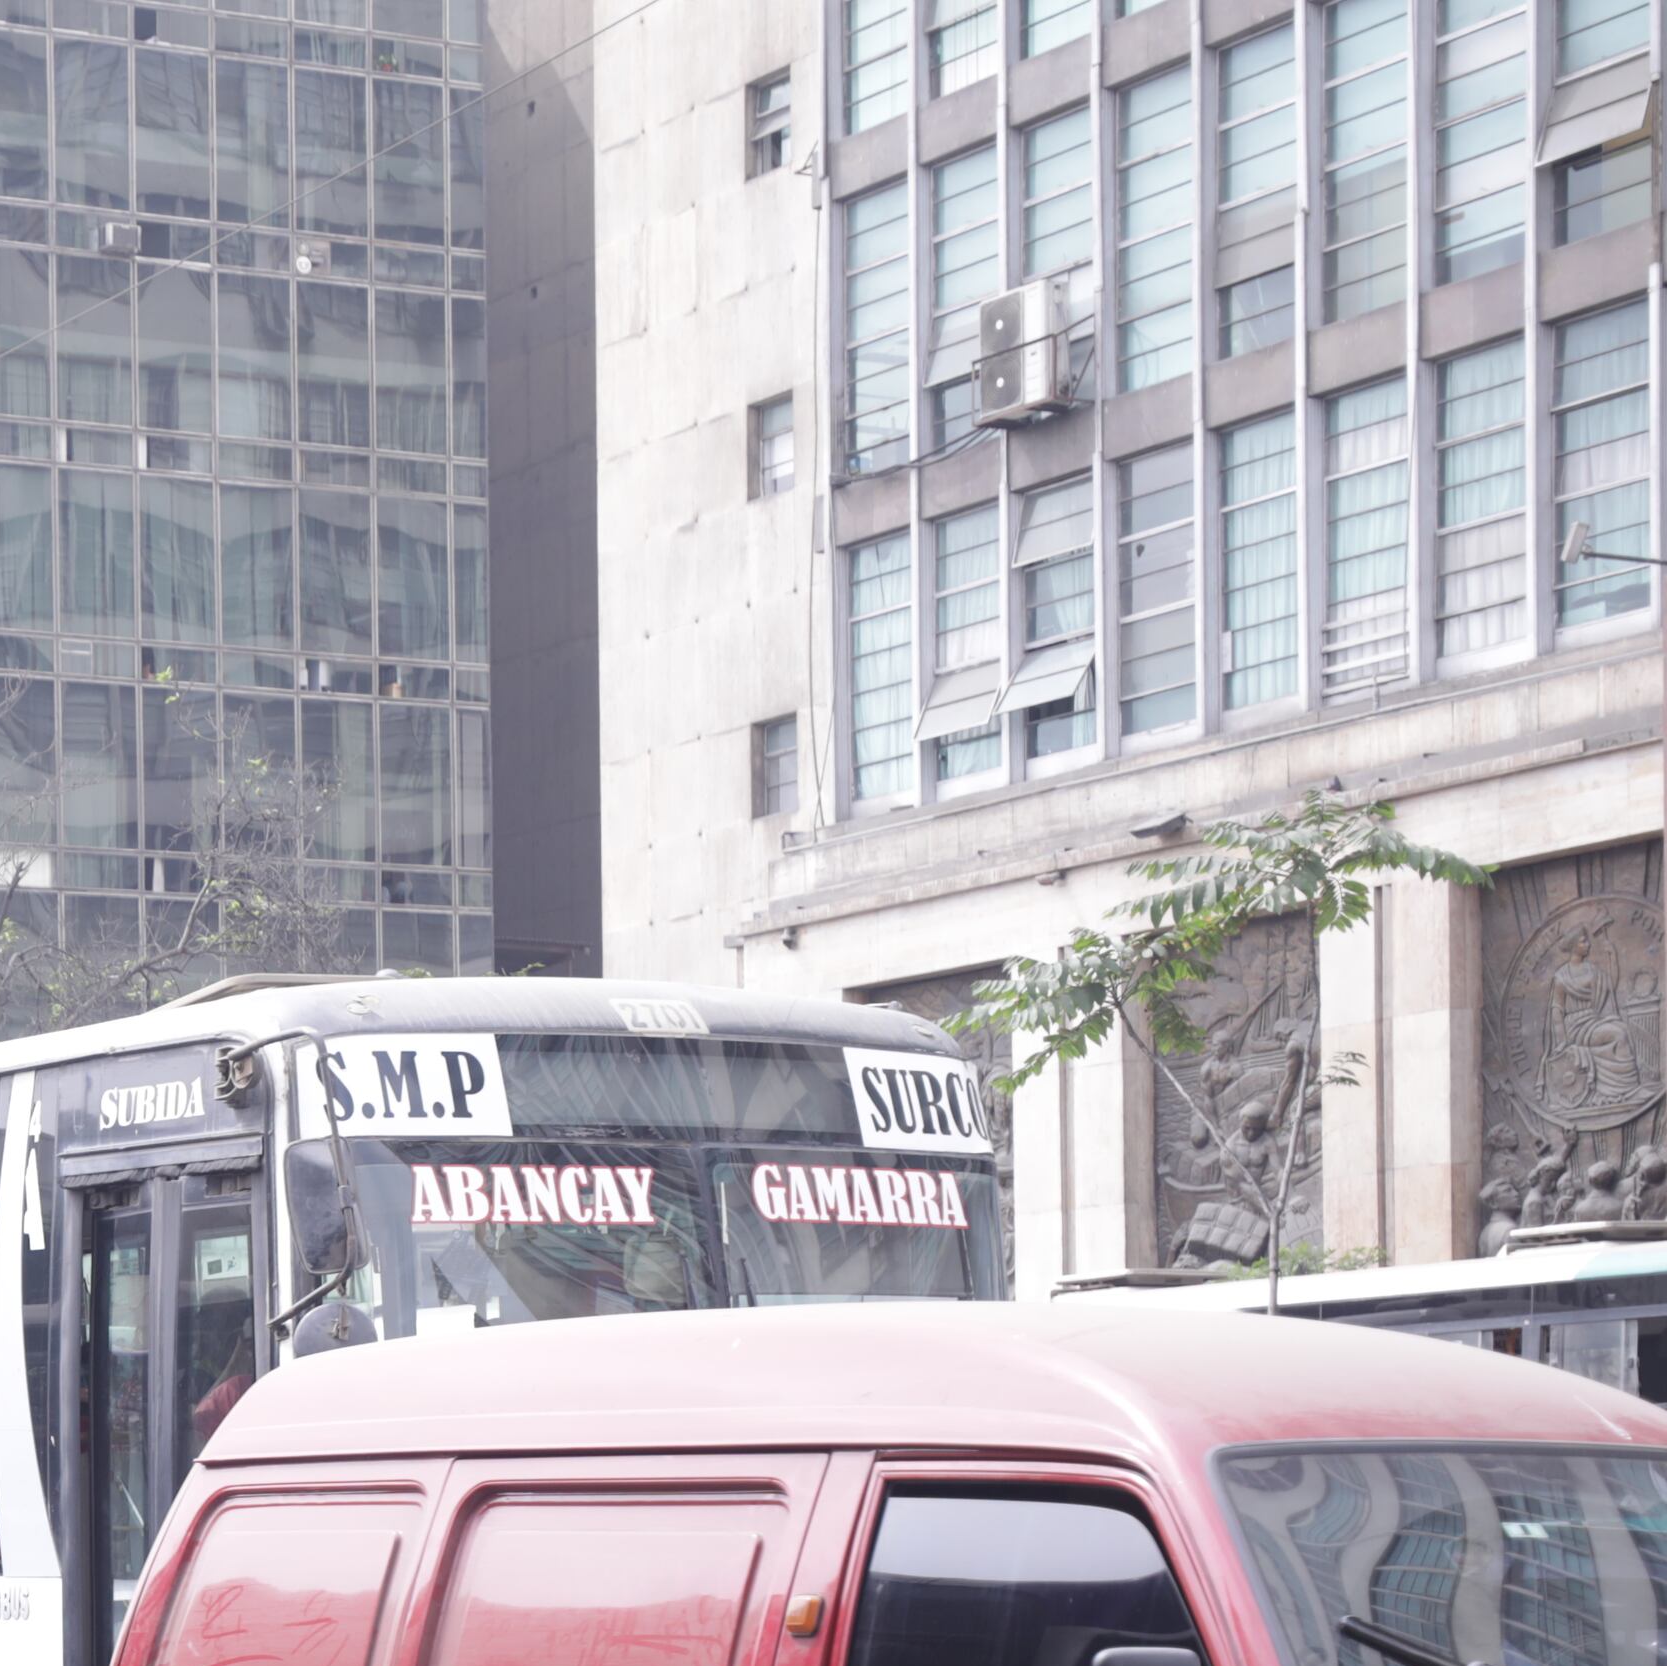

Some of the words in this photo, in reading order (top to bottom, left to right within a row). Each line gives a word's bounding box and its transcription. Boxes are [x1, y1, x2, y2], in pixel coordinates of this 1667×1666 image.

[99, 1075, 206, 1131] SUBIDA
[861, 1065, 989, 1141] SURCO
[410, 1163, 655, 1226] ABANCAY
[751, 1163, 970, 1230] GAMARRA
